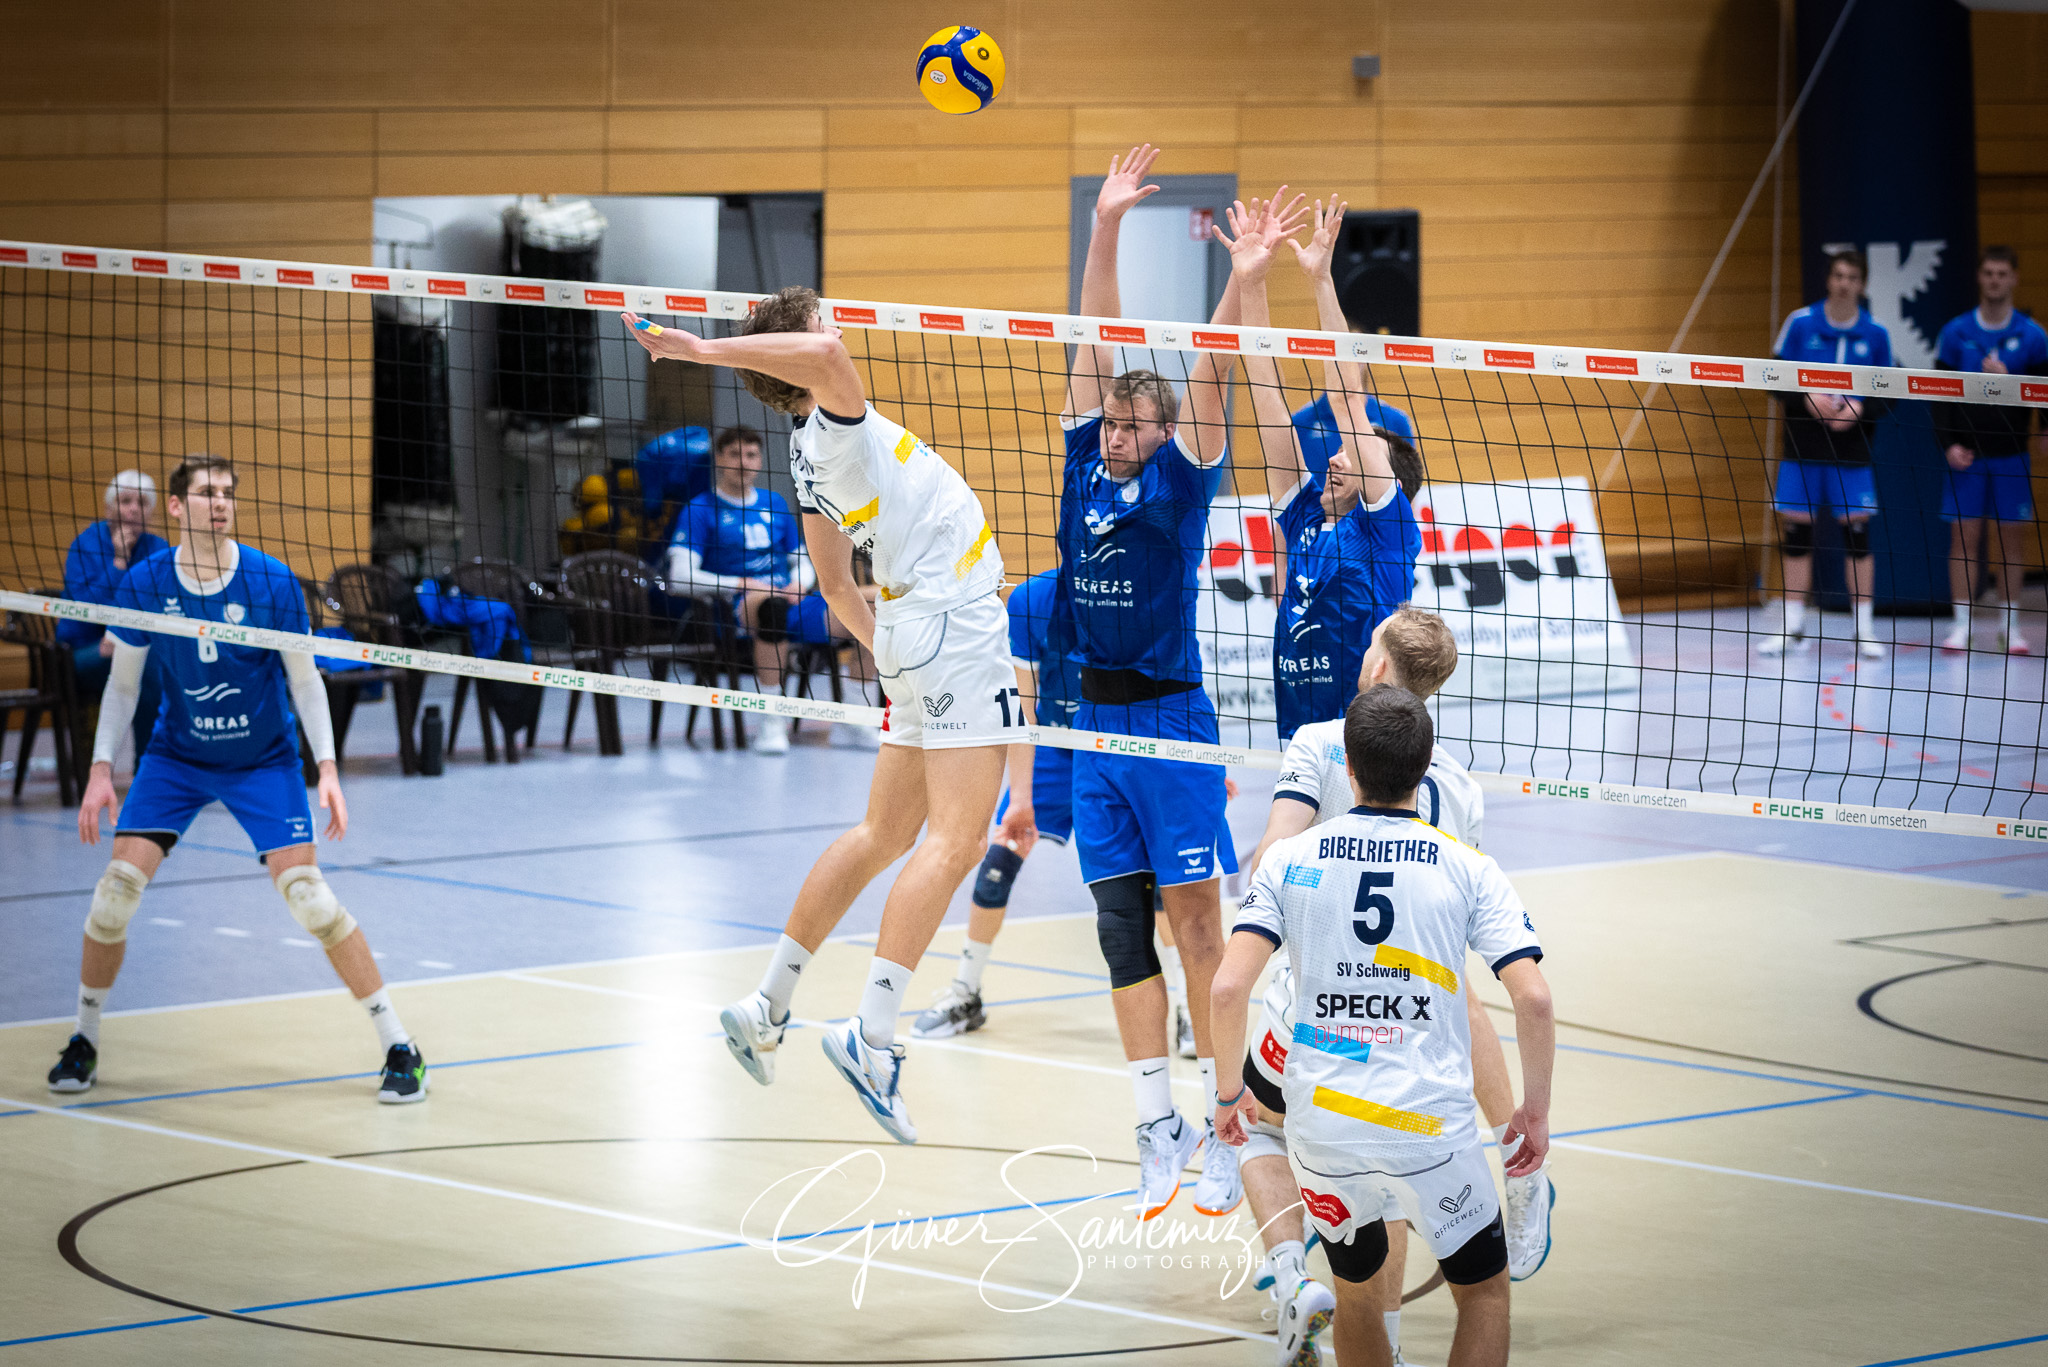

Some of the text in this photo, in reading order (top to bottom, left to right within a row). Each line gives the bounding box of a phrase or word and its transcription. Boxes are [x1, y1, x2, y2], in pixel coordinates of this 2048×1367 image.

[1767, 374, 1780, 382] Zapf
[1830, 378, 1849, 386] Nürnberg
[1940, 386, 1960, 394] Nürnberg
[1988, 388, 2001, 396] Zapf
[54, 604, 90, 619] FUCHS
[1097, 599, 1134, 607] unlimted
[210, 626, 247, 642] FUCHS
[373, 650, 412, 664] FUCHS
[544, 672, 661, 697] FUCHS Ideen umsetzen
[724, 695, 845, 720] FUCHS Ideen umsetzen
[1110, 740, 1244, 765] FUCHS Ideen umsetzen
[1538, 784, 1687, 808] FUCHS Ideen umsetzen
[1769, 804, 1927, 830] FUCHS Ideen umsetzen
[2014, 825, 2048, 839] FUC
[1318, 836, 1439, 865] BIBELRIETHER
[1352, 871, 1395, 946] 5
[1337, 962, 1411, 982] SV Schwaig
[1315, 993, 1404, 1020] SPECK
[1314, 1024, 1403, 1049] pumpen
[1434, 1203, 1485, 1239] OFFICEWELT
